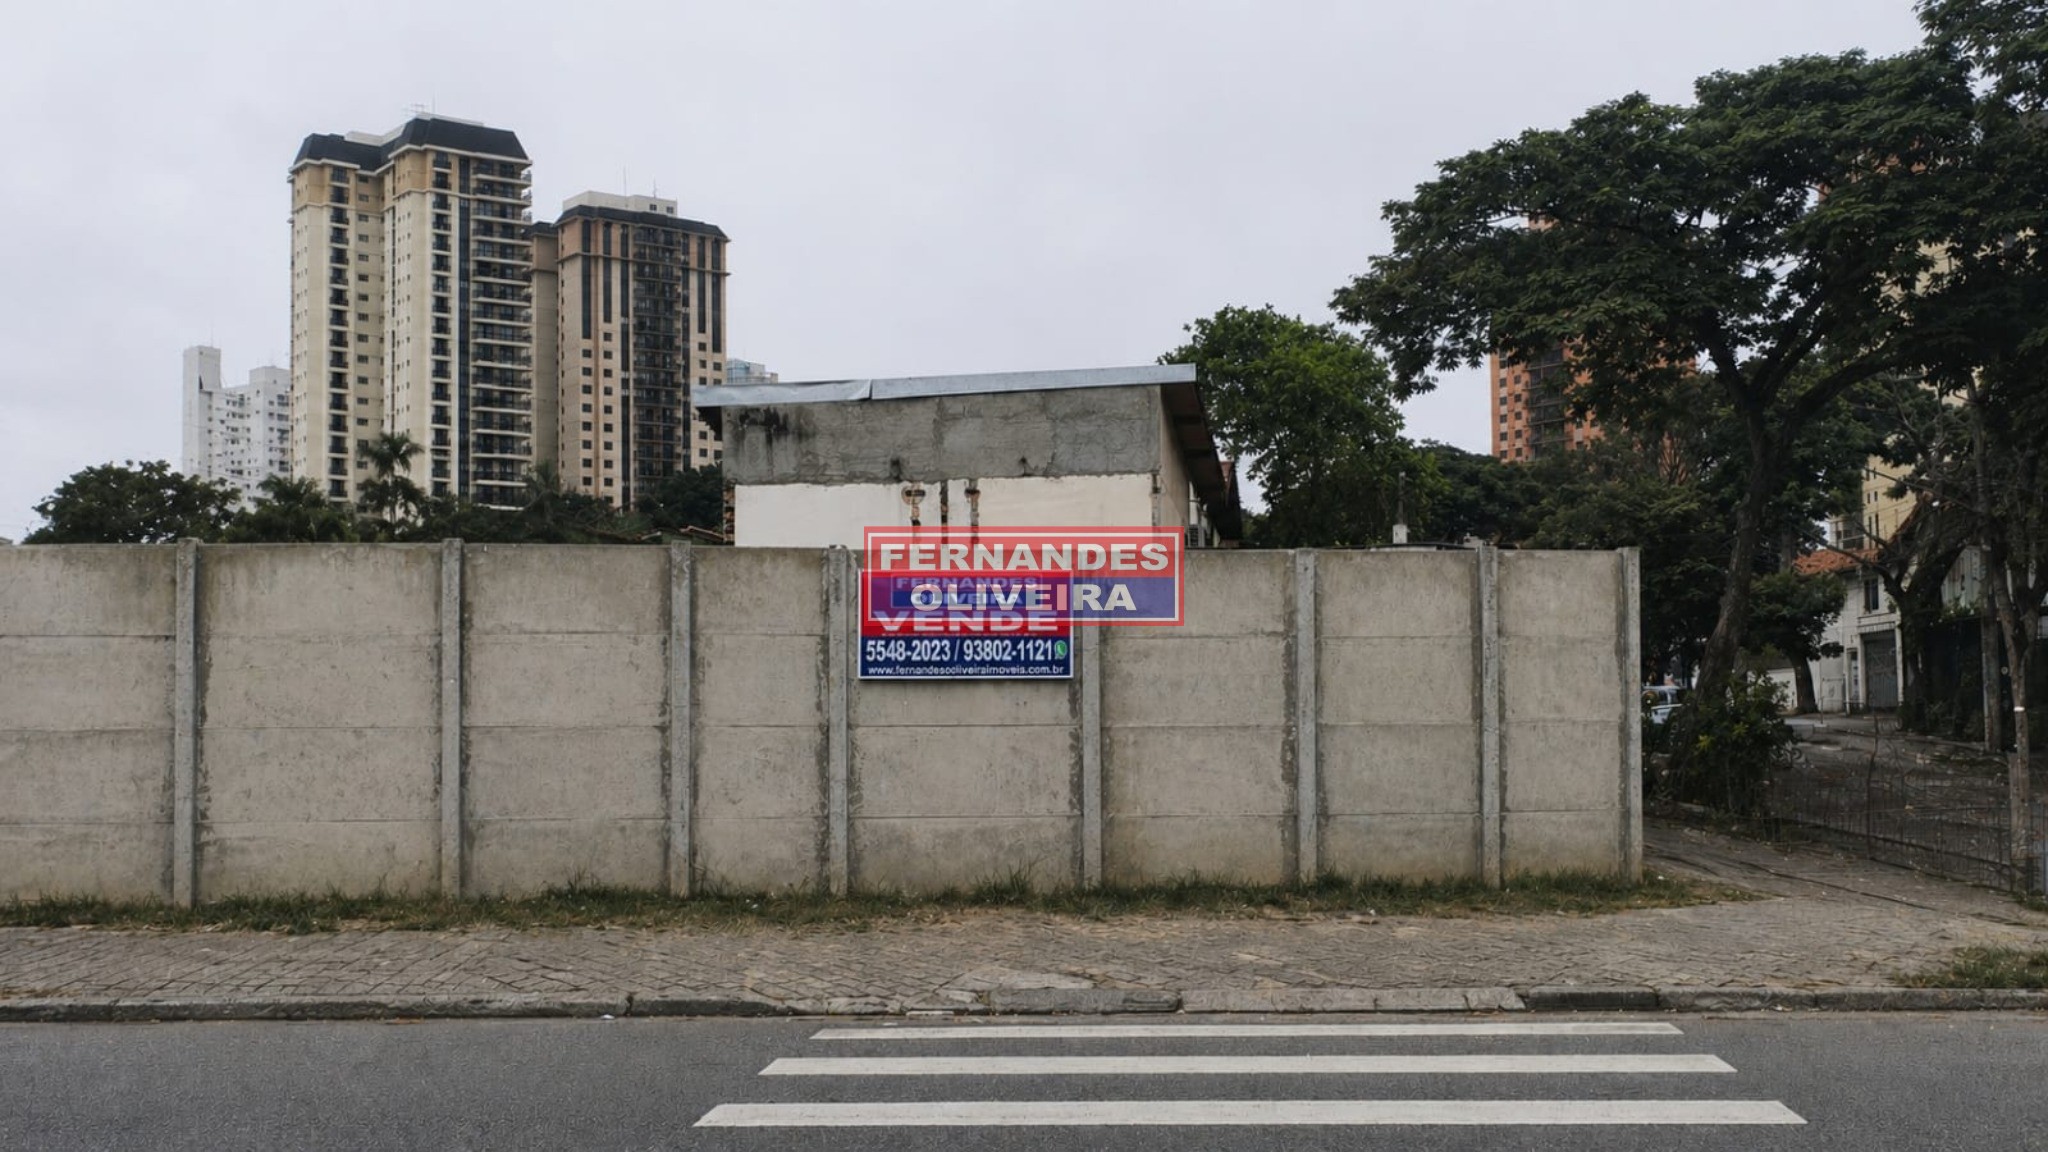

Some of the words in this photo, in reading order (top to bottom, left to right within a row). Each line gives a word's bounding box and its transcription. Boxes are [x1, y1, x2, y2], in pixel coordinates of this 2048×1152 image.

[896, 577, 1038, 589] FERNANDES
[873, 611, 1058, 631] VENDE
[866, 640, 951, 661] 5548-2023
[963, 640, 1052, 661] 93802-1121
